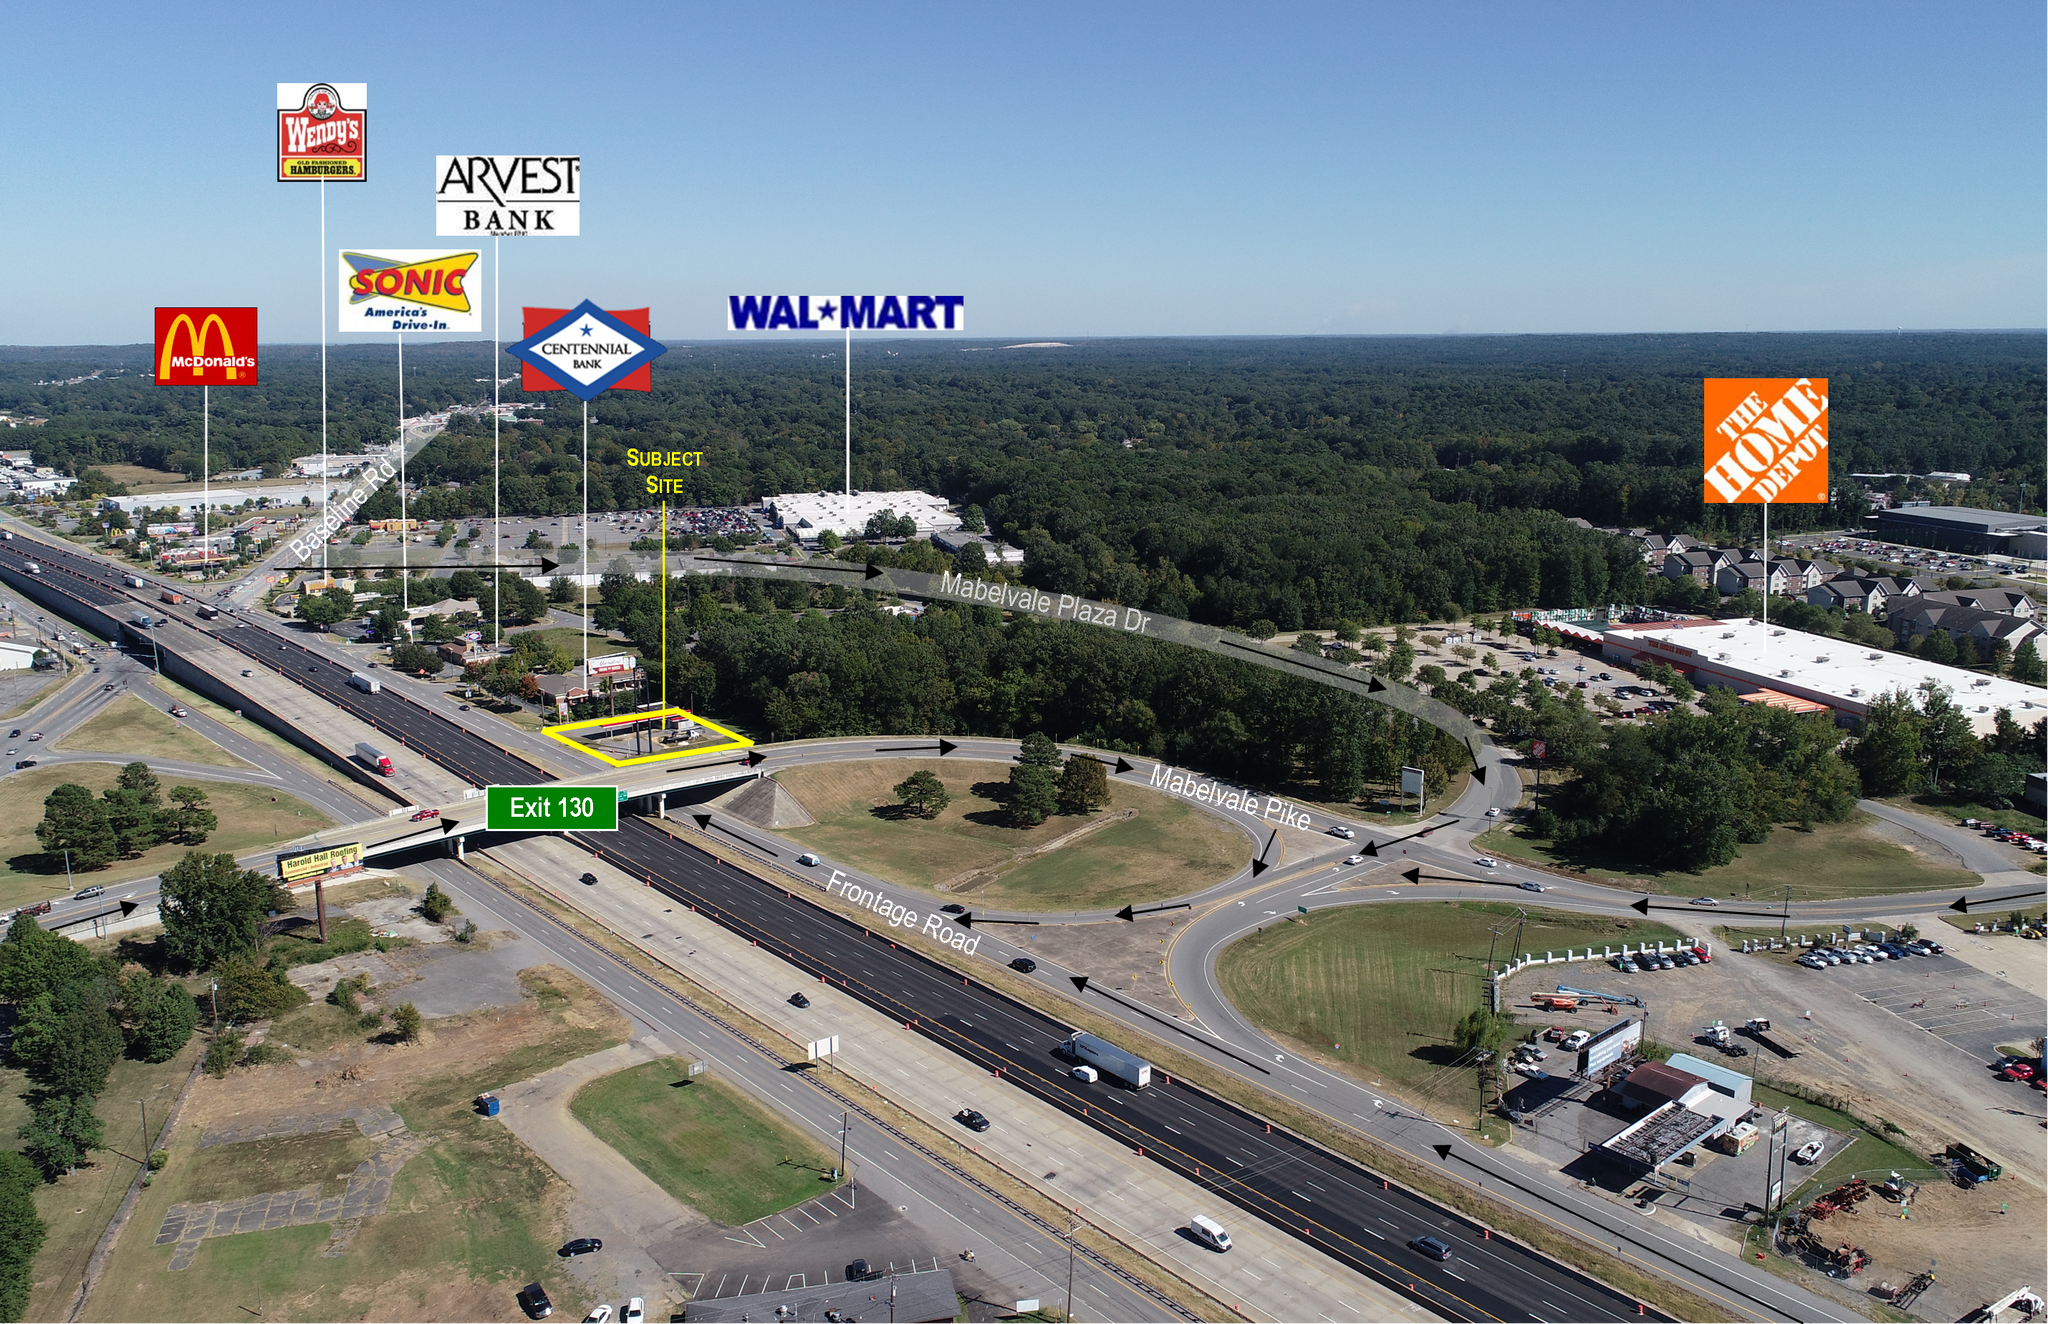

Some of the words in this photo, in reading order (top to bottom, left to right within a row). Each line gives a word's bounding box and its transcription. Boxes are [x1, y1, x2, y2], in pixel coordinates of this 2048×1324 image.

[287, 856, 312, 869] Harold
[313, 852, 328, 862] Hall
[330, 846, 358, 858] Roofing
